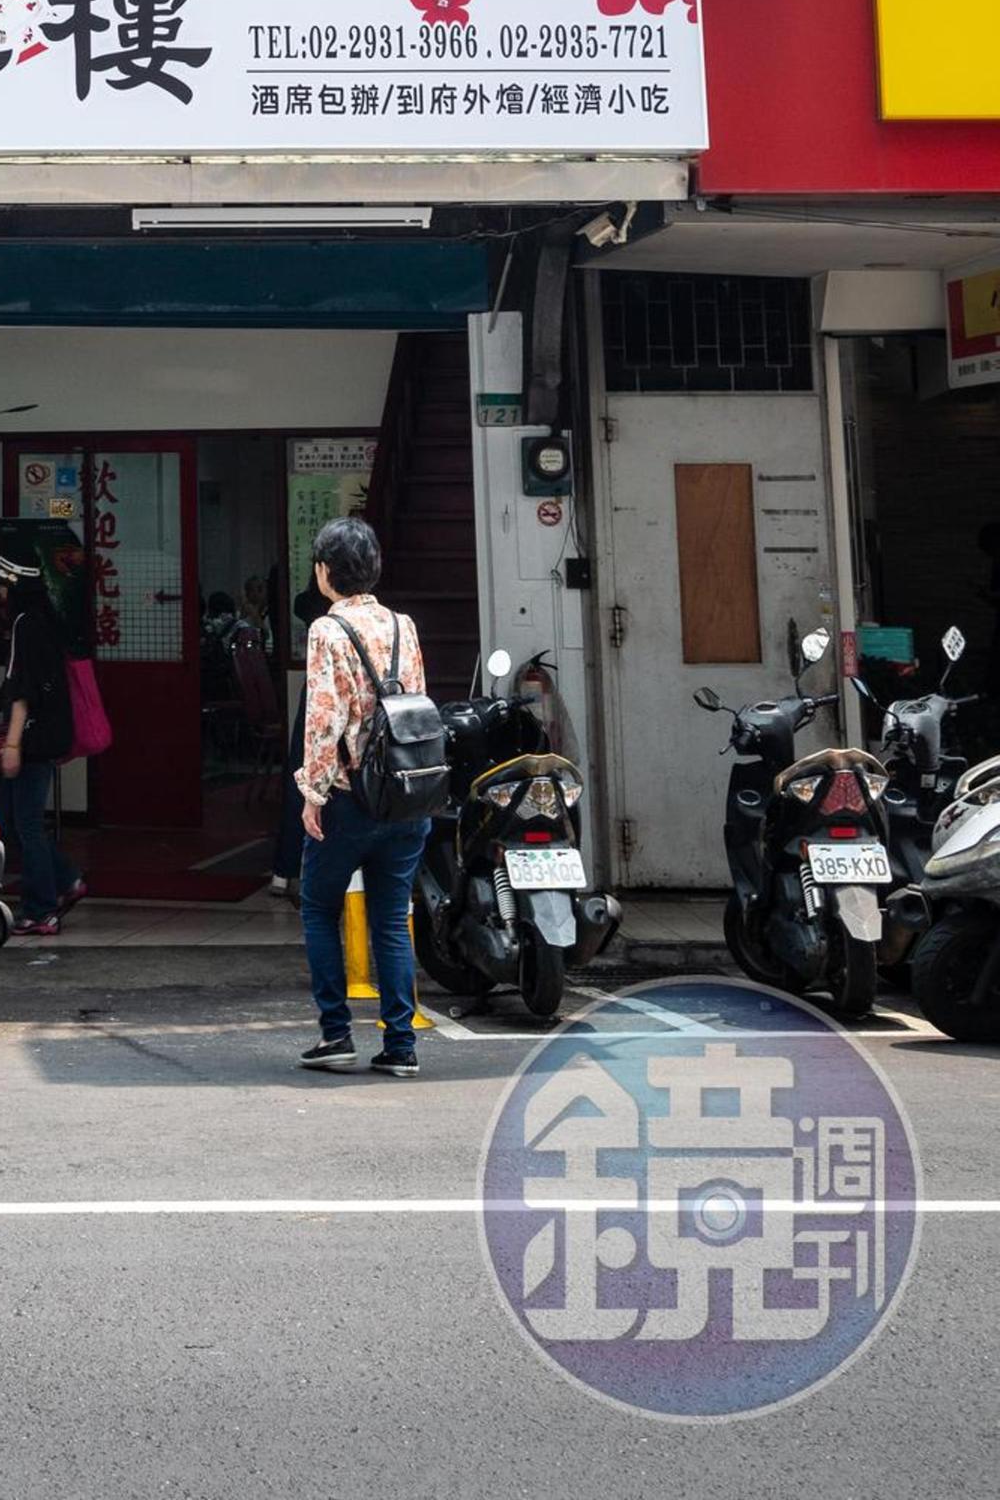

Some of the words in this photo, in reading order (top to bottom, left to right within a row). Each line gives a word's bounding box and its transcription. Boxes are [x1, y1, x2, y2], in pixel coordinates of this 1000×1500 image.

[499, 24, 669, 59] 02-2935-7721
[251, 83, 670, 116] 酒席包辦/到府外燴/經濟小吃
[481, 407, 519, 423] 121
